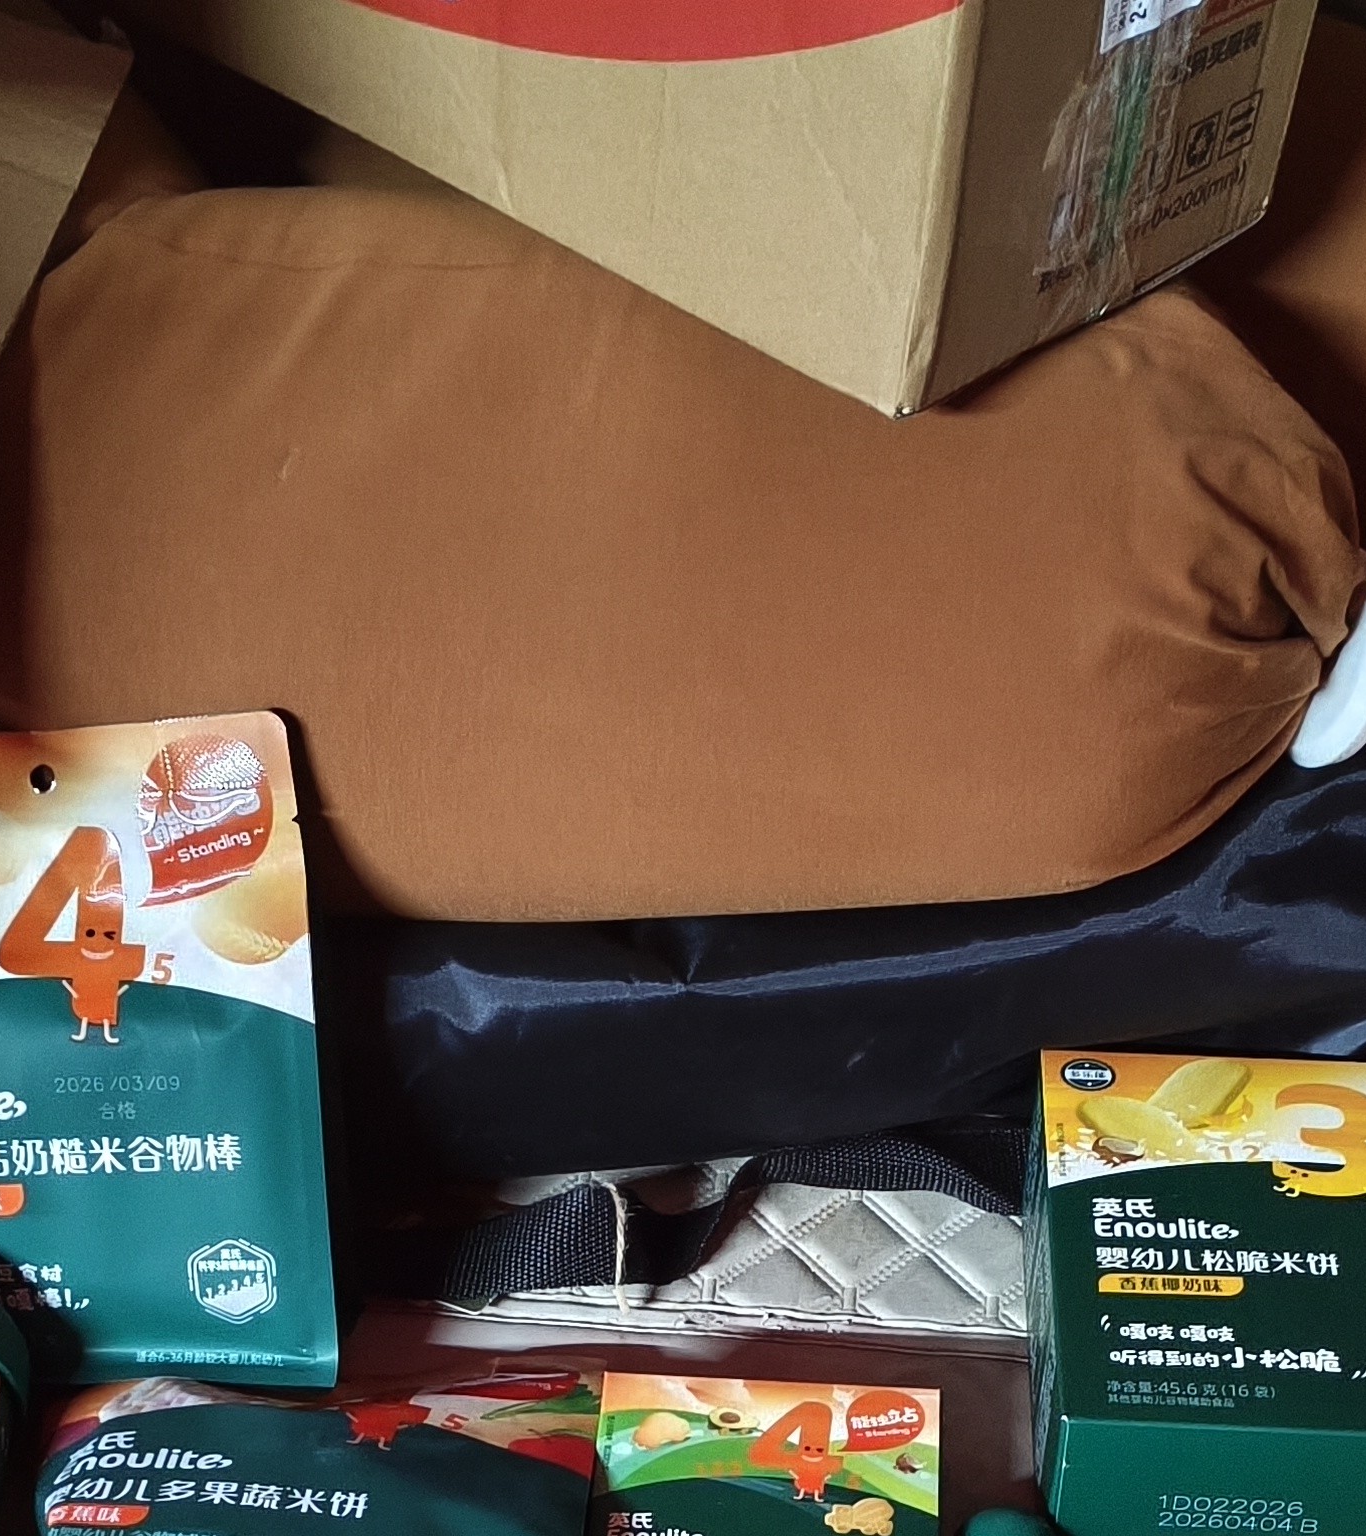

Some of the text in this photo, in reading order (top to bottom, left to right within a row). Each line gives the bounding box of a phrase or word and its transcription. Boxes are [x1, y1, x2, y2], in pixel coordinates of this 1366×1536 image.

[176, 831, 253, 864] Standing
[151, 952, 175, 985] 5
[98, 1101, 137, 1120] 合格
[1092, 1197, 1156, 1219] 英氏
[1093, 1217, 1237, 1241] Enoulite
[1095, 1245, 1340, 1277] 婴幼儿松脆米饼
[1118, 1276, 1224, 1294] 香蕉椰奶味
[1109, 1346, 1341, 1374] 听得到的小松脆
[441, 1414, 470, 1431] 5
[748, 1400, 844, 1503] 4
[1158, 1495, 1303, 1518] 1D022026
[607, 1511, 653, 1529] 英氏
[1158, 1511, 1299, 1534] 20260404
